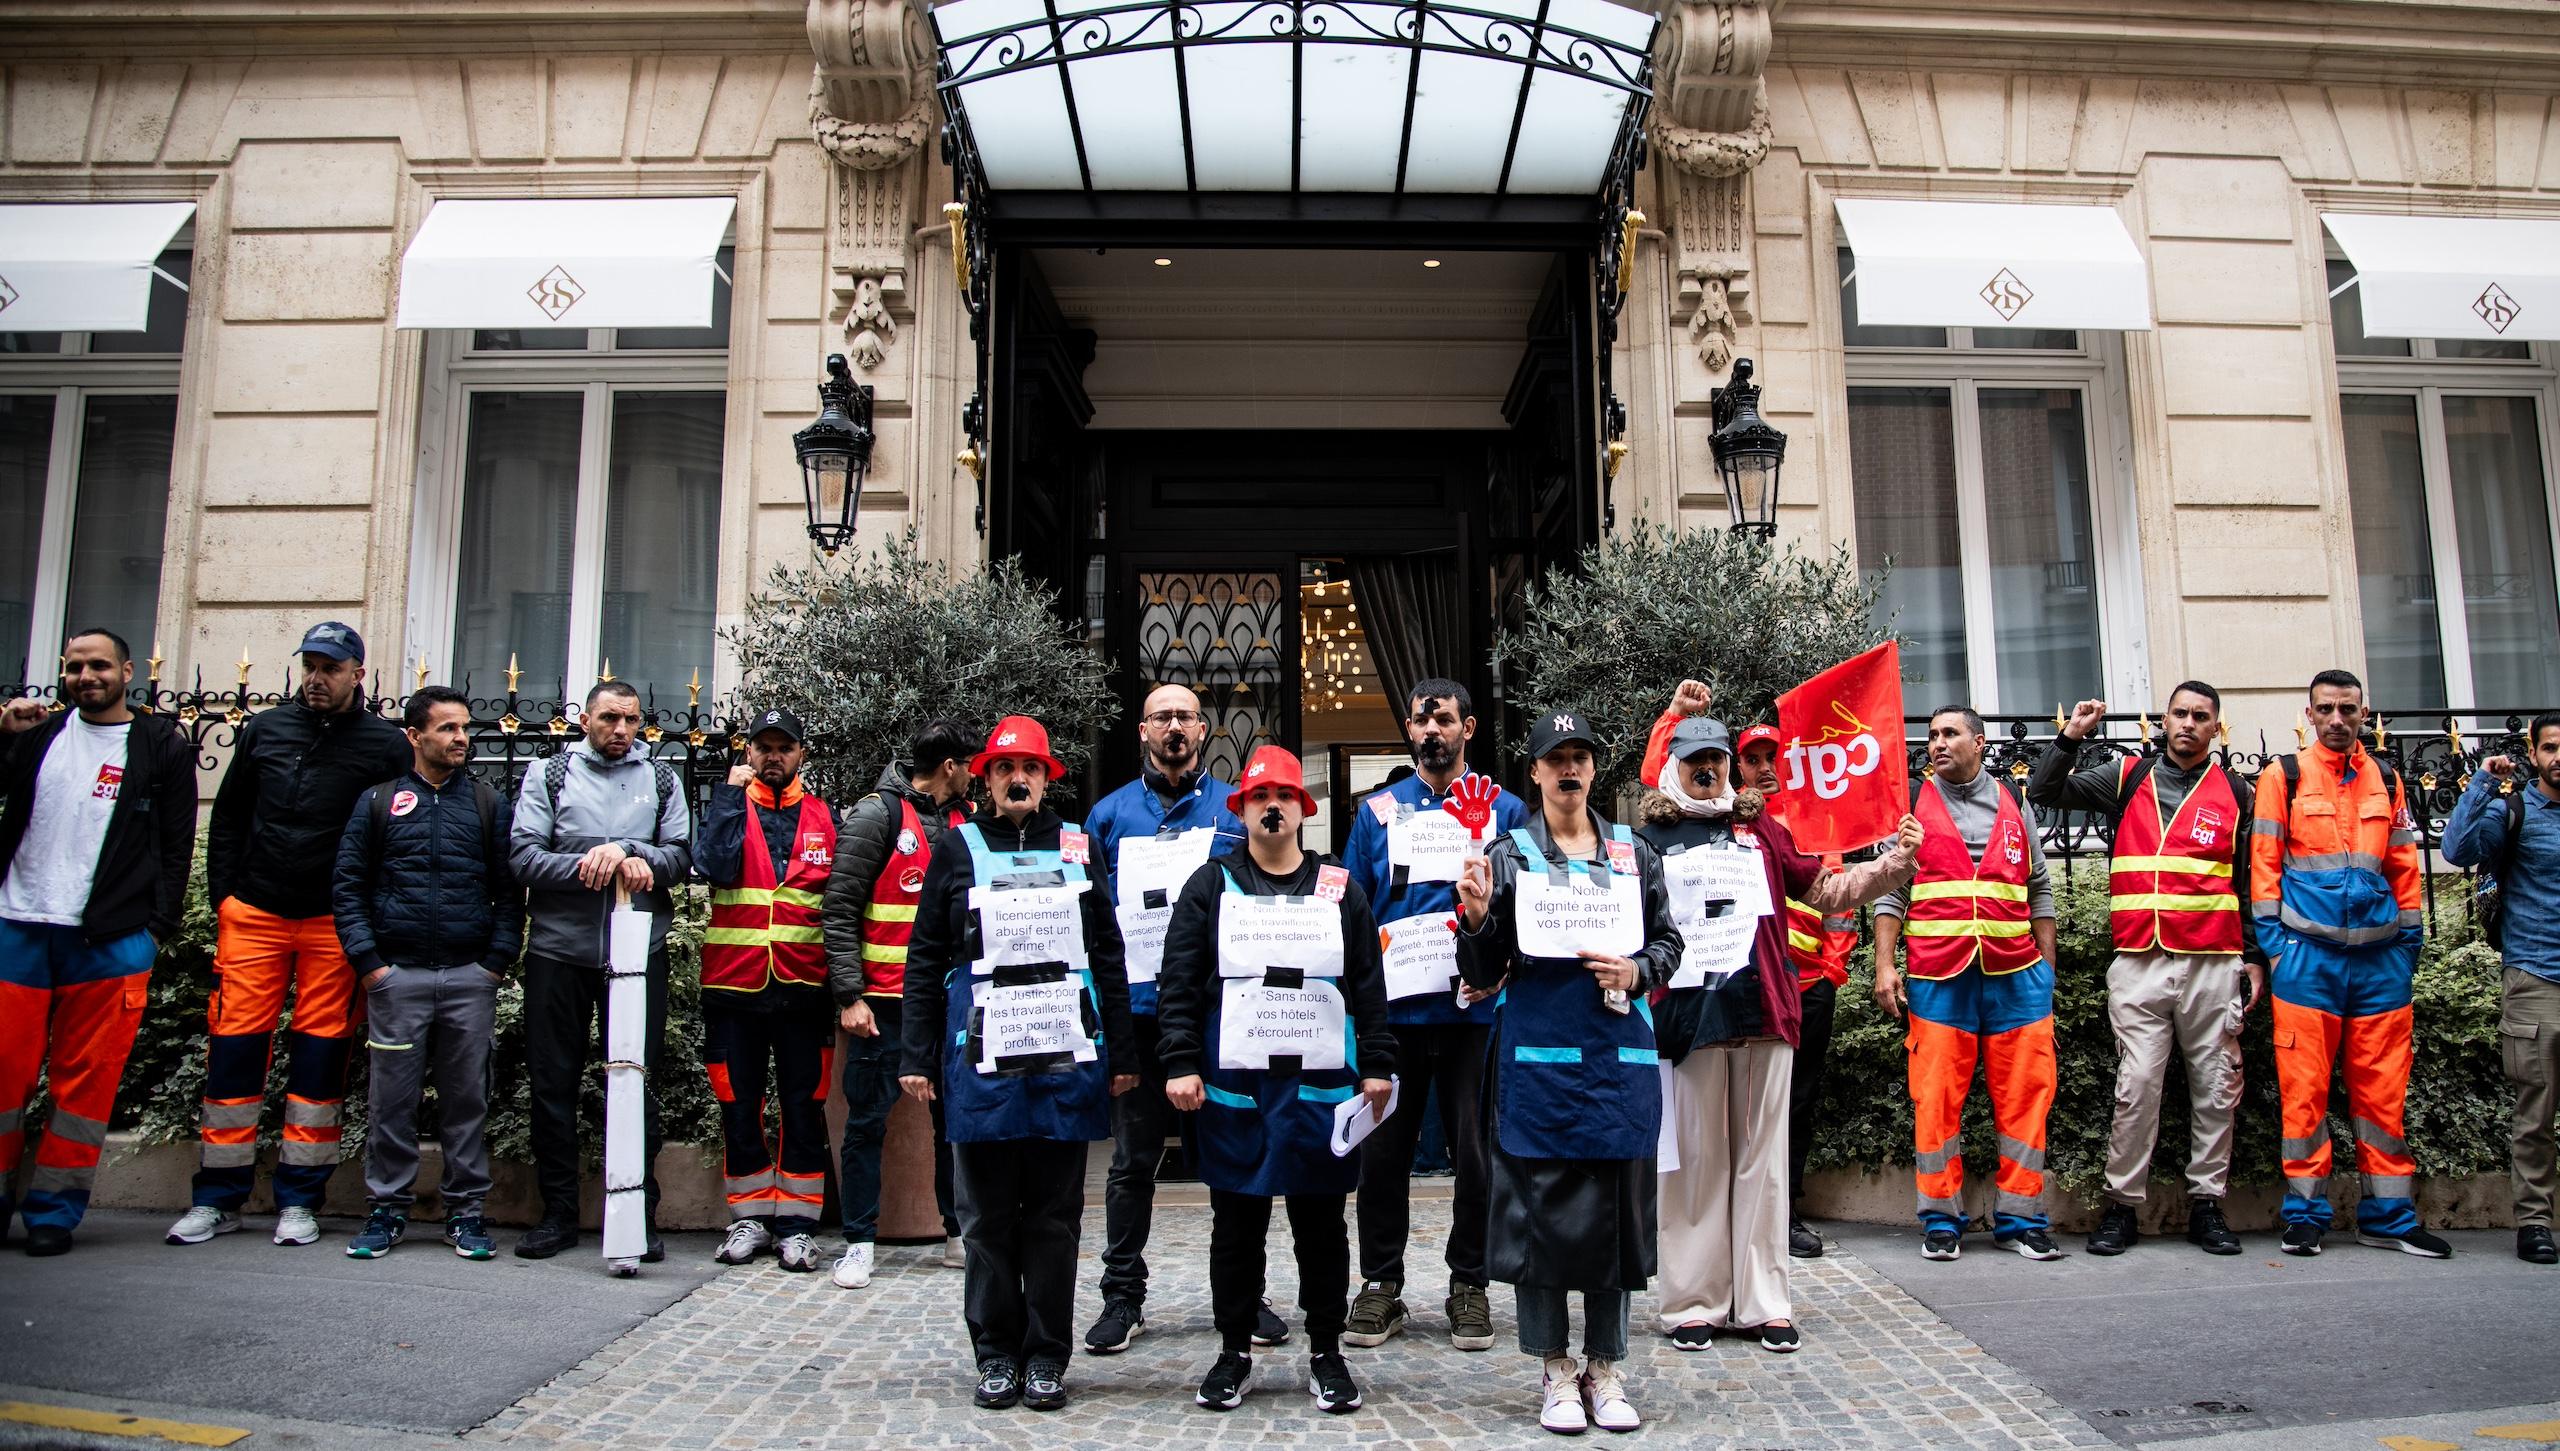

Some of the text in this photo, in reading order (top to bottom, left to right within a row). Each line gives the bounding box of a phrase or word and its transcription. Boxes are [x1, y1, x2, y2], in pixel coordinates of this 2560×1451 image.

[1553, 715, 1575, 731] NY
[997, 733, 1016, 746] cgt
[1248, 762, 1265, 777] cgt
[1467, 810, 1484, 822] cgt
[1411, 832, 1435, 842] SAS
[2192, 827, 2216, 845] cgt
[1411, 844, 1462, 854] Humanité
[805, 847, 827, 865] cgt
[1061, 848, 1090, 864] cgt
[1682, 865, 1704, 873] SAS
[1708, 876, 1717, 885] la
[1705, 889, 1733, 899] l'abus
[1534, 900, 1621, 914] dignité avant
[995, 909, 1071, 921] licenciement
[1536, 919, 1561, 929] vos
[1565, 917, 1606, 931] profits
[995, 925, 1071, 937] abusif est un
[1230, 932, 1249, 943] pas
[1252, 931, 1272, 941] des
[1275, 931, 1322, 941] esclaves
[1012, 940, 1045, 952] crime
[1142, 940, 1154, 949] les
[1427, 937, 1450, 947] mais
[1692, 945, 1709, 955] vos
[1393, 955, 1416, 968] mains
[1418, 952, 1439, 962] sont
[1055, 987, 1077, 998] pour
[1299, 993, 1332, 1004] nous,
[990, 1007, 1008, 1019] les
[1256, 1008, 1316, 1020] vos hôtels
[1000, 1018, 1072, 1036] pas pour les
[1247, 1026, 1312, 1038] s'écroulent
[1004, 1034, 1058, 1052] profiteurs
